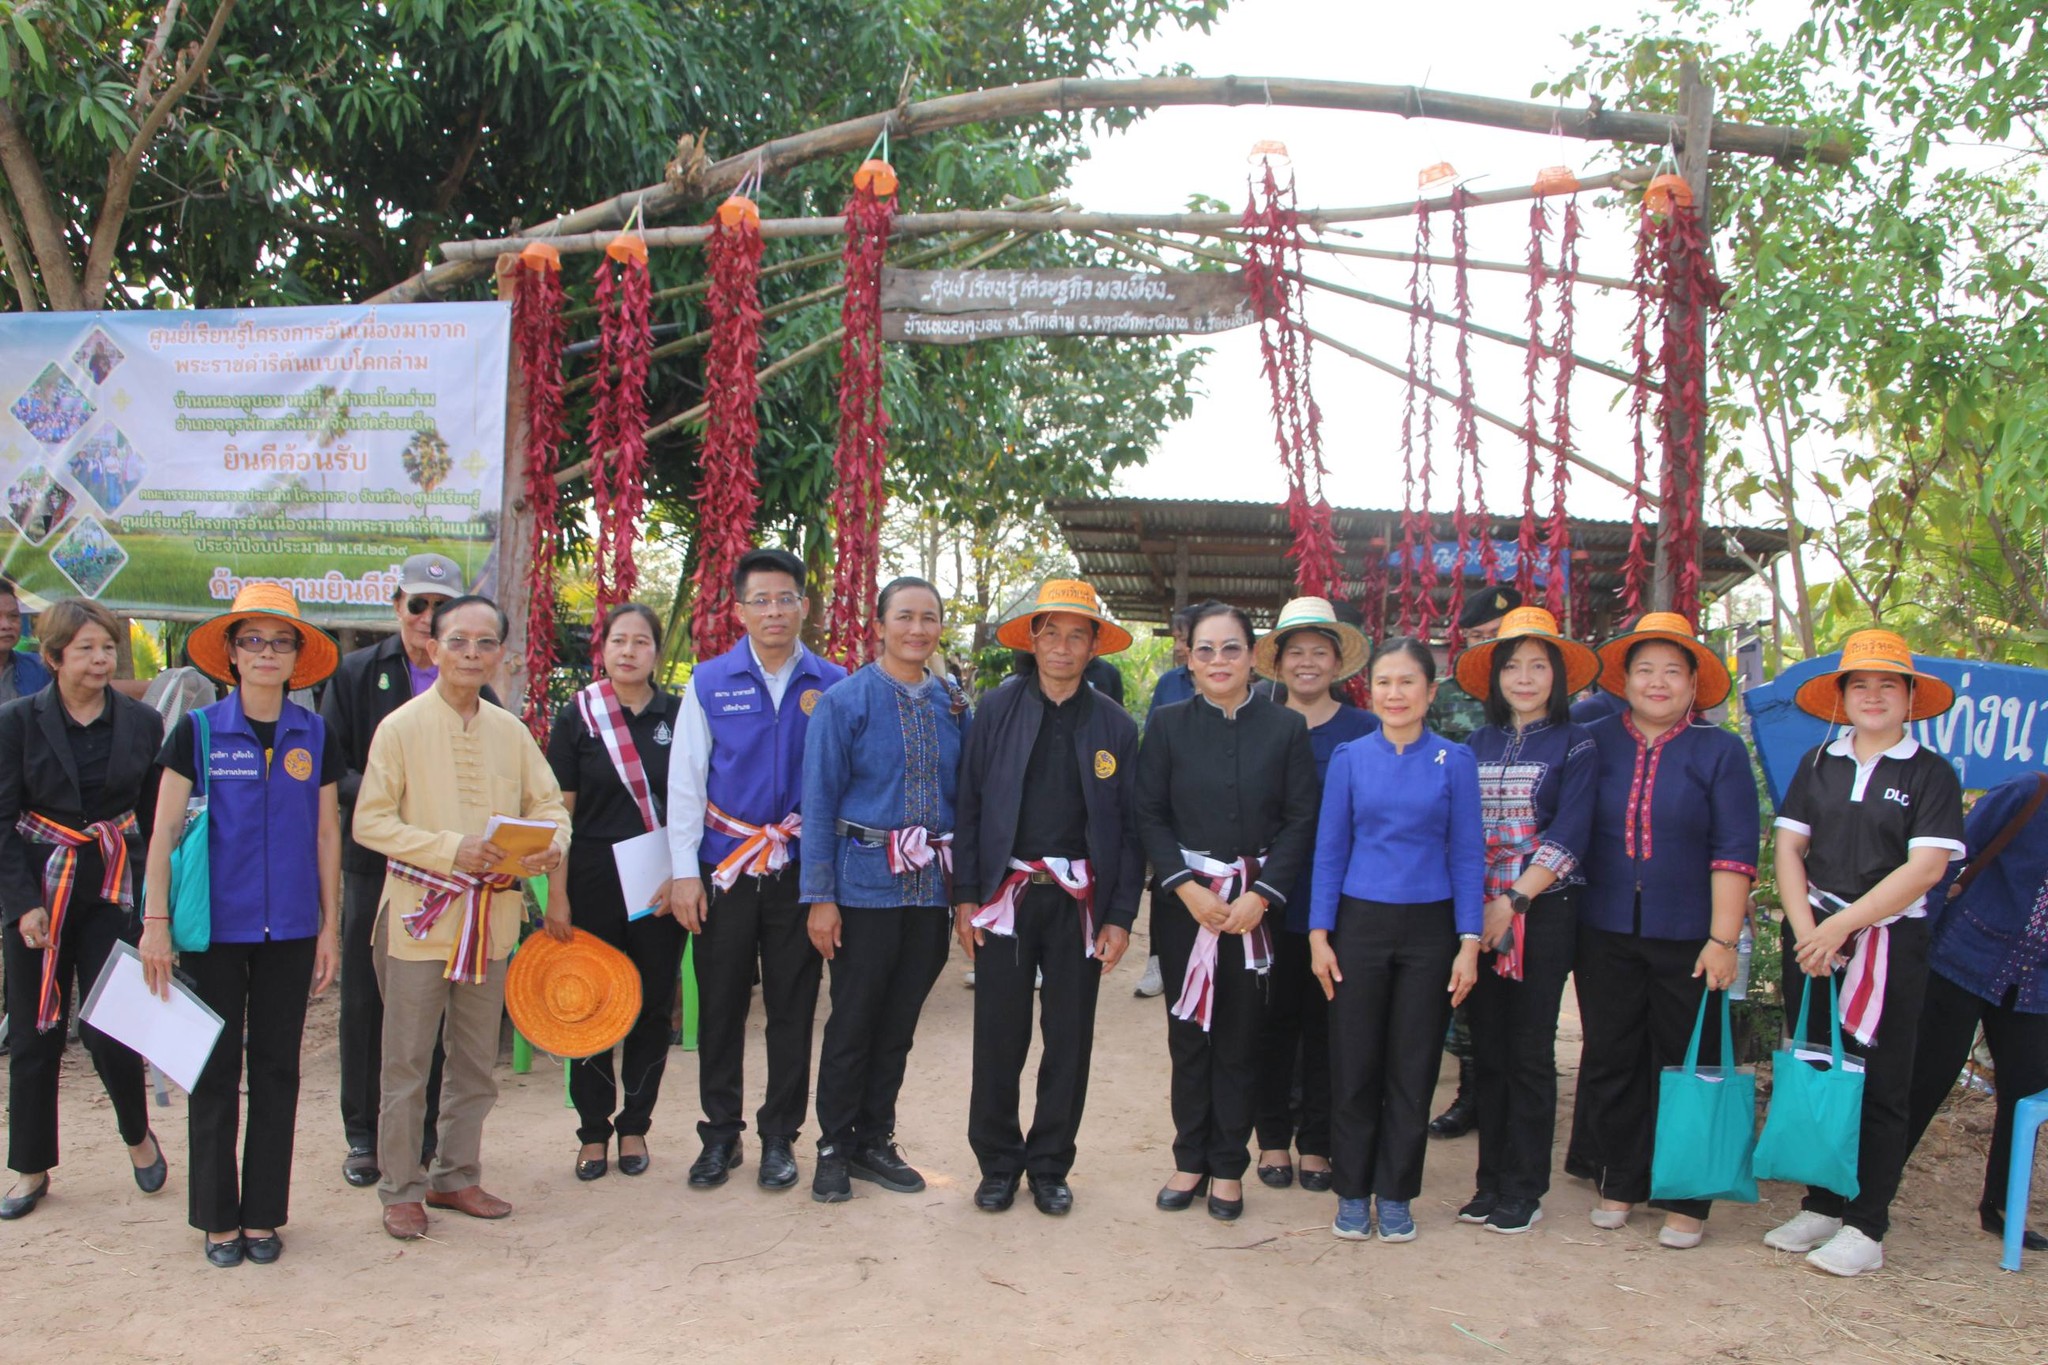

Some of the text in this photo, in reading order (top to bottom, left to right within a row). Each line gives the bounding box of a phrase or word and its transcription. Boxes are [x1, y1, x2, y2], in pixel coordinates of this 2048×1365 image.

[150, 312, 466, 350] ศูนย์เรียนรู้โครงการอันเนื่องมาจาก
[174, 348, 429, 374] พระราชดำริต้นแบบโคกล่าม
[223, 443, 368, 472] ยินดีต้อนรับ
